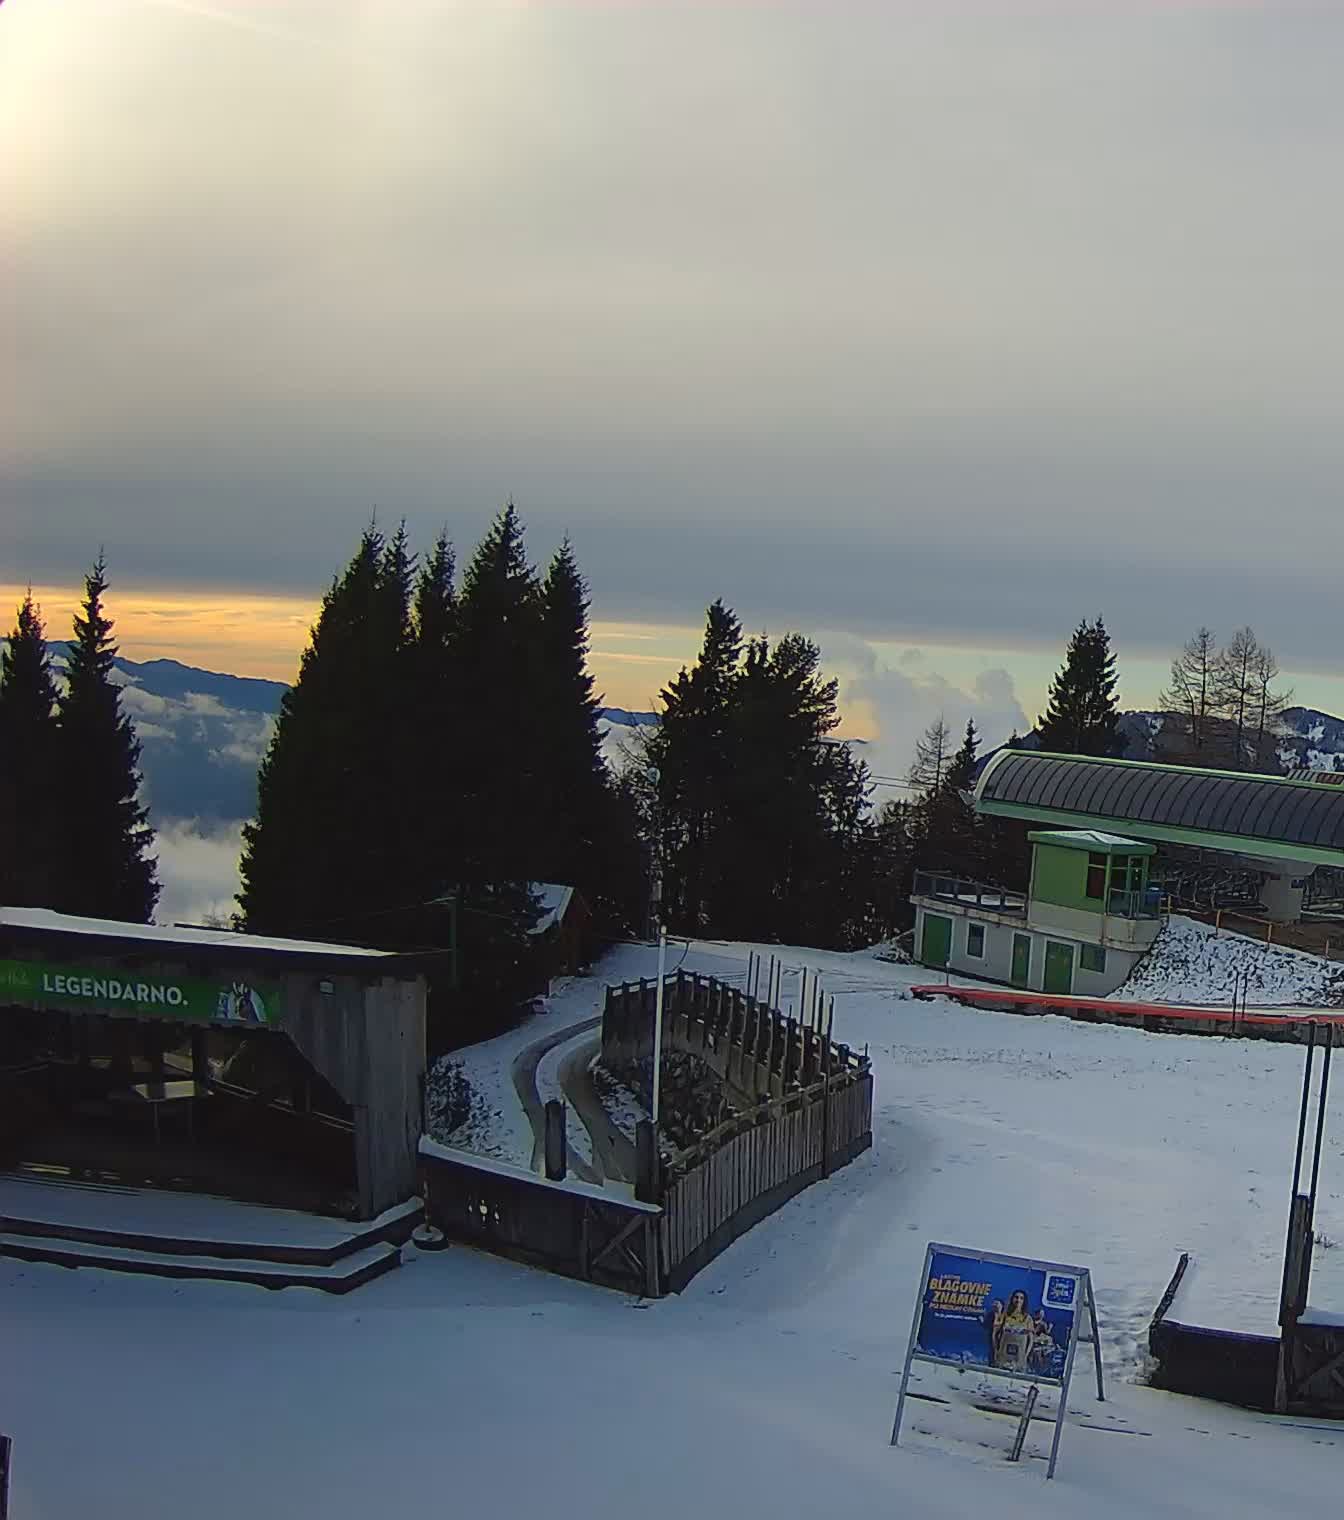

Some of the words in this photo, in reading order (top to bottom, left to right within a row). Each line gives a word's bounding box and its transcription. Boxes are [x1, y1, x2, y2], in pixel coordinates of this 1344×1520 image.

[43, 973, 189, 1006] LEGENDARNO.
[929, 1278, 992, 1296] BLAGOVNE
[932, 1291, 985, 1307] ZNAMKE
